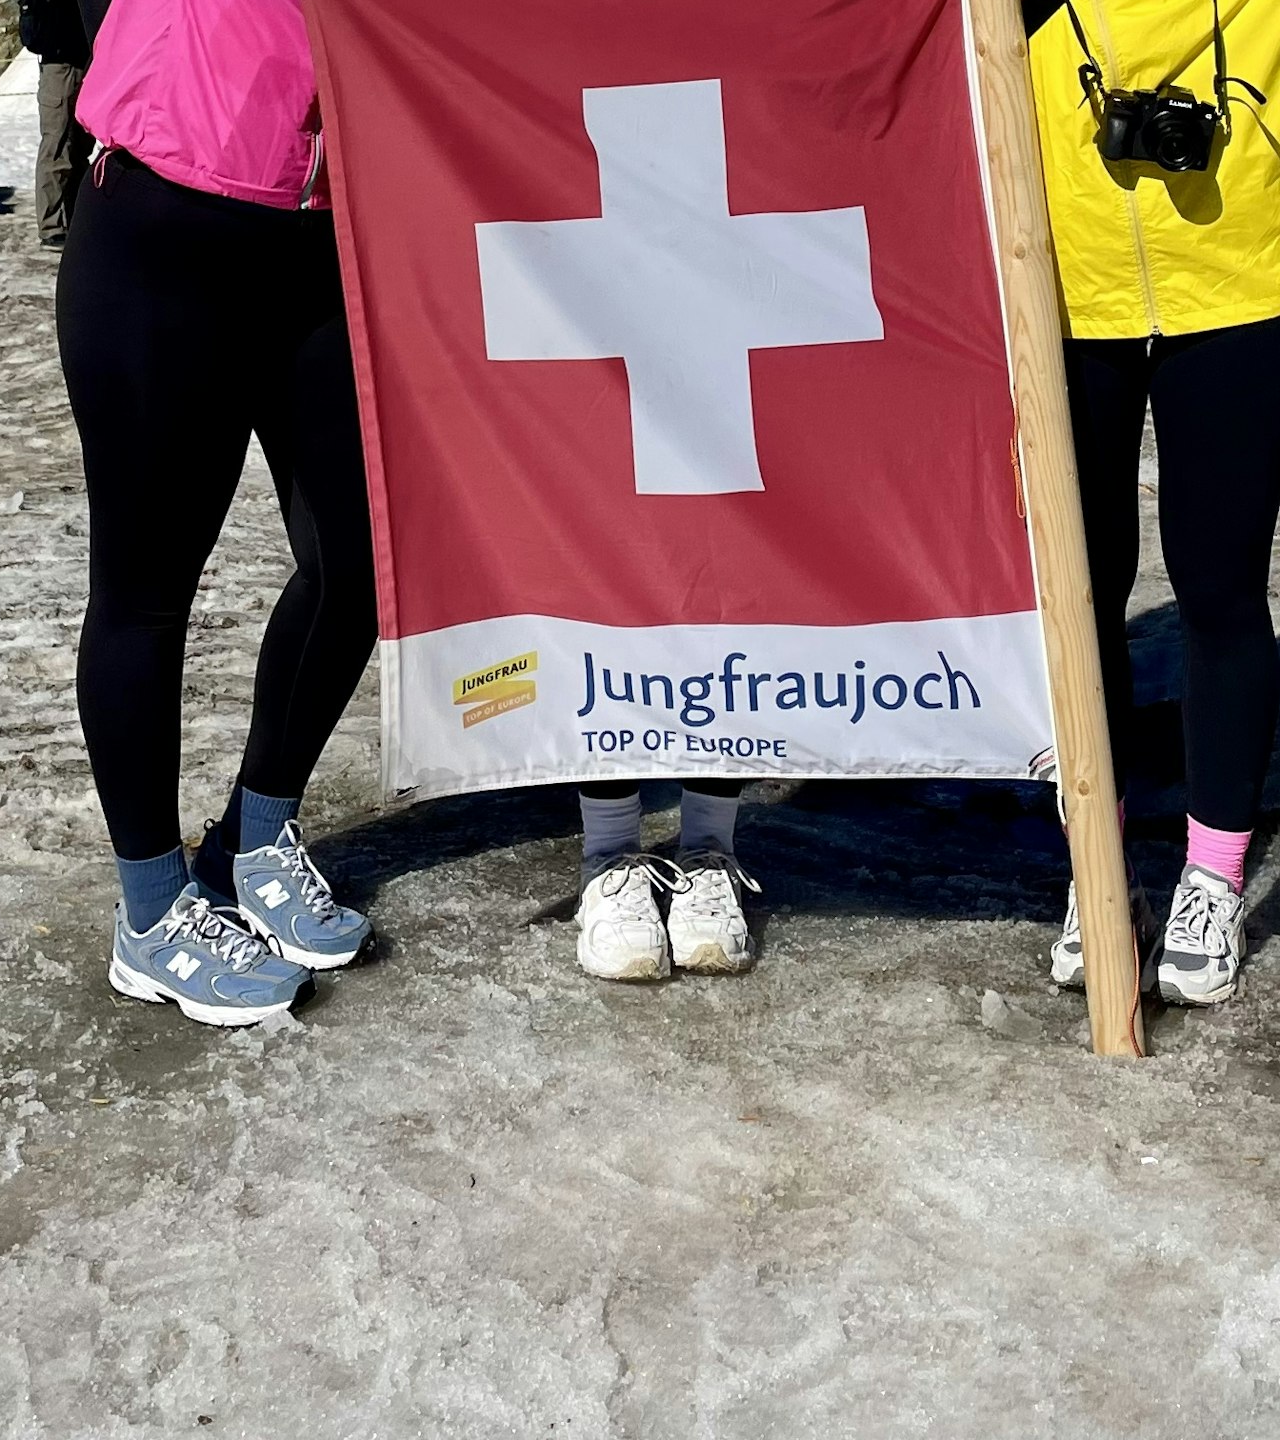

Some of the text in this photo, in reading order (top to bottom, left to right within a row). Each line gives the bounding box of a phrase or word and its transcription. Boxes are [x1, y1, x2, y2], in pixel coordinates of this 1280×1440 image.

[462, 658, 528, 695] JUNGFRAU
[577, 650, 981, 728] Jungfraujoch
[465, 692, 532, 723] TOP OF EUROPE
[581, 729, 788, 758] TOP OF EUROPE
